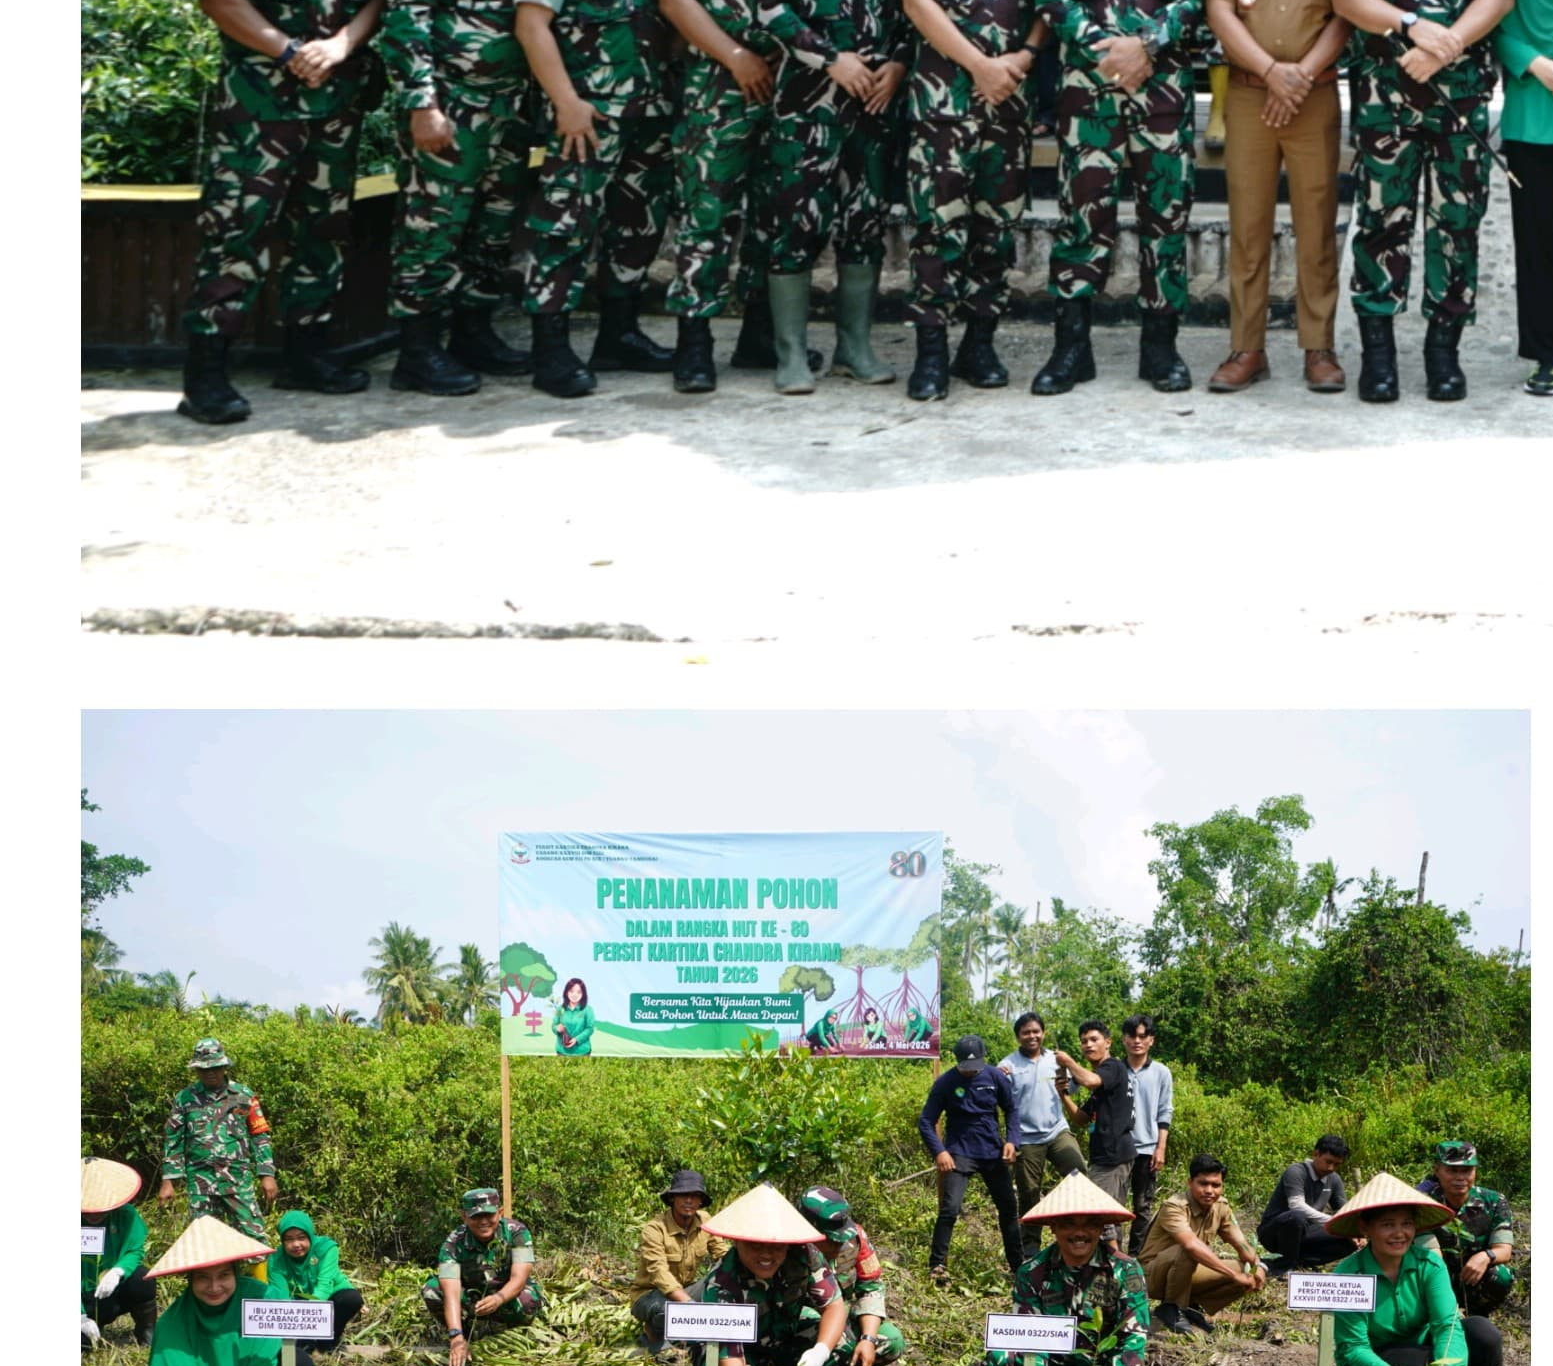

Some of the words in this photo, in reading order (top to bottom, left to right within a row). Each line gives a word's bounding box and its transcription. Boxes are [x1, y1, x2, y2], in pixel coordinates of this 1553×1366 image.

[889, 850, 926, 878] 80
[597, 877, 748, 909] PENANAMAN
[757, 878, 838, 909] POHON
[625, 920, 672, 937] DALAM
[676, 920, 728, 937] RANGKA
[732, 920, 757, 937] HUT
[761, 920, 777, 937] KE
[791, 920, 809, 938] 80
[593, 942, 643, 961] PERSIT
[648, 942, 708, 962] KARTIKA
[713, 942, 783, 962] CHANDRA
[788, 942, 842, 962] KIRANA
[676, 966, 718, 983] TAHUN
[722, 966, 758, 983] 2026
[641, 995, 688, 1006] Bersama
[690, 995, 712, 1006] Kita
[714, 995, 761, 1012] Hijaukan
[763, 995, 791, 1006] Bumi
[634, 1009, 658, 1020] Satu
[660, 1009, 694, 1020] Pohon
[696, 1009, 728, 1020] Untuk
[730, 1010, 755, 1020] Masa
[761, 1010, 799, 1023] Depan!
[868, 1041, 887, 1051] Siak,
[889, 1041, 894, 1049] 4
[895, 1041, 909, 1050] Mei
[911, 1041, 930, 1050] 2026
[266, 1315, 299, 1323] CABANG
[296, 1308, 322, 1316] PERSIT
[671, 1317, 707, 1325] DANDIM
[709, 1318, 751, 1327] 0322/SIAK
[993, 1327, 1026, 1336] KASDIM
[1027, 1329, 1069, 1338] 0322/SIAK
